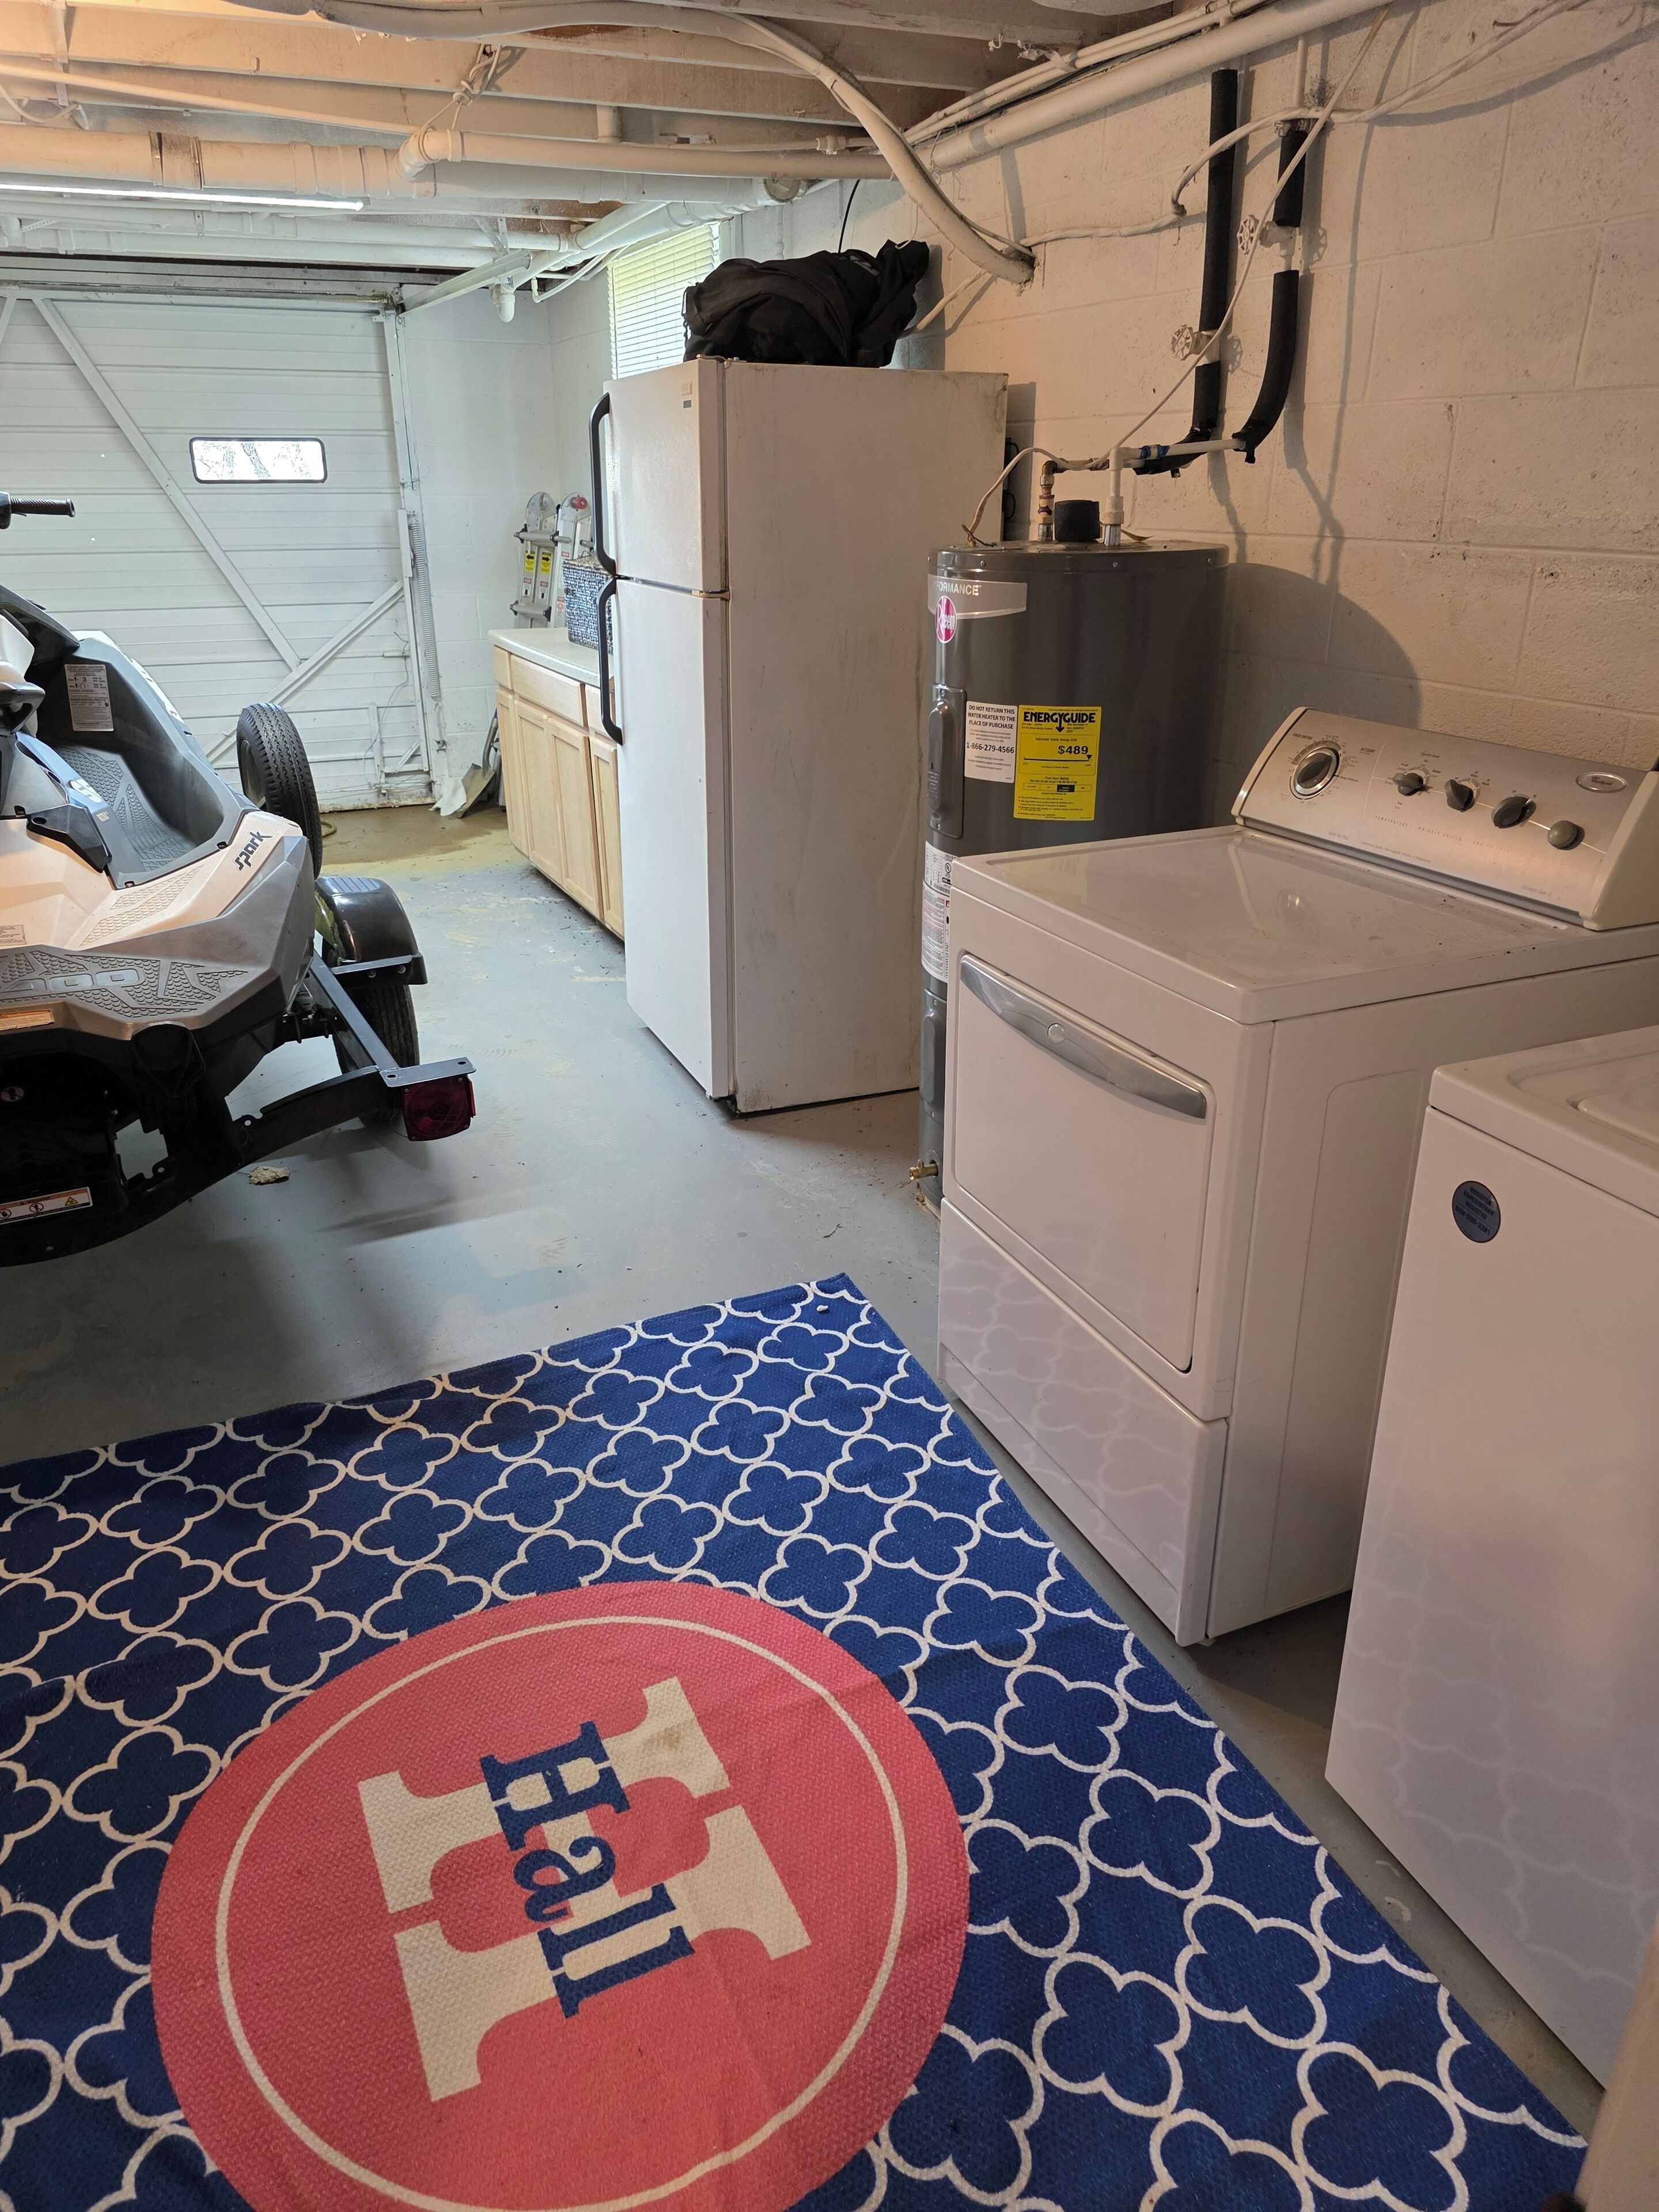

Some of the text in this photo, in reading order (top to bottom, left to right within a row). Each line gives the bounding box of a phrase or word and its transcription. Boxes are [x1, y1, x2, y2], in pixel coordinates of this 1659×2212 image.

[1023, 711, 1096, 724] ENERGYGUIDE
[966, 741, 1014, 754] 1-866-279-4566
[1058, 745, 1089, 755] $489
[234, 831, 274, 871] spark
[480, 1721, 695, 2018] Hall
